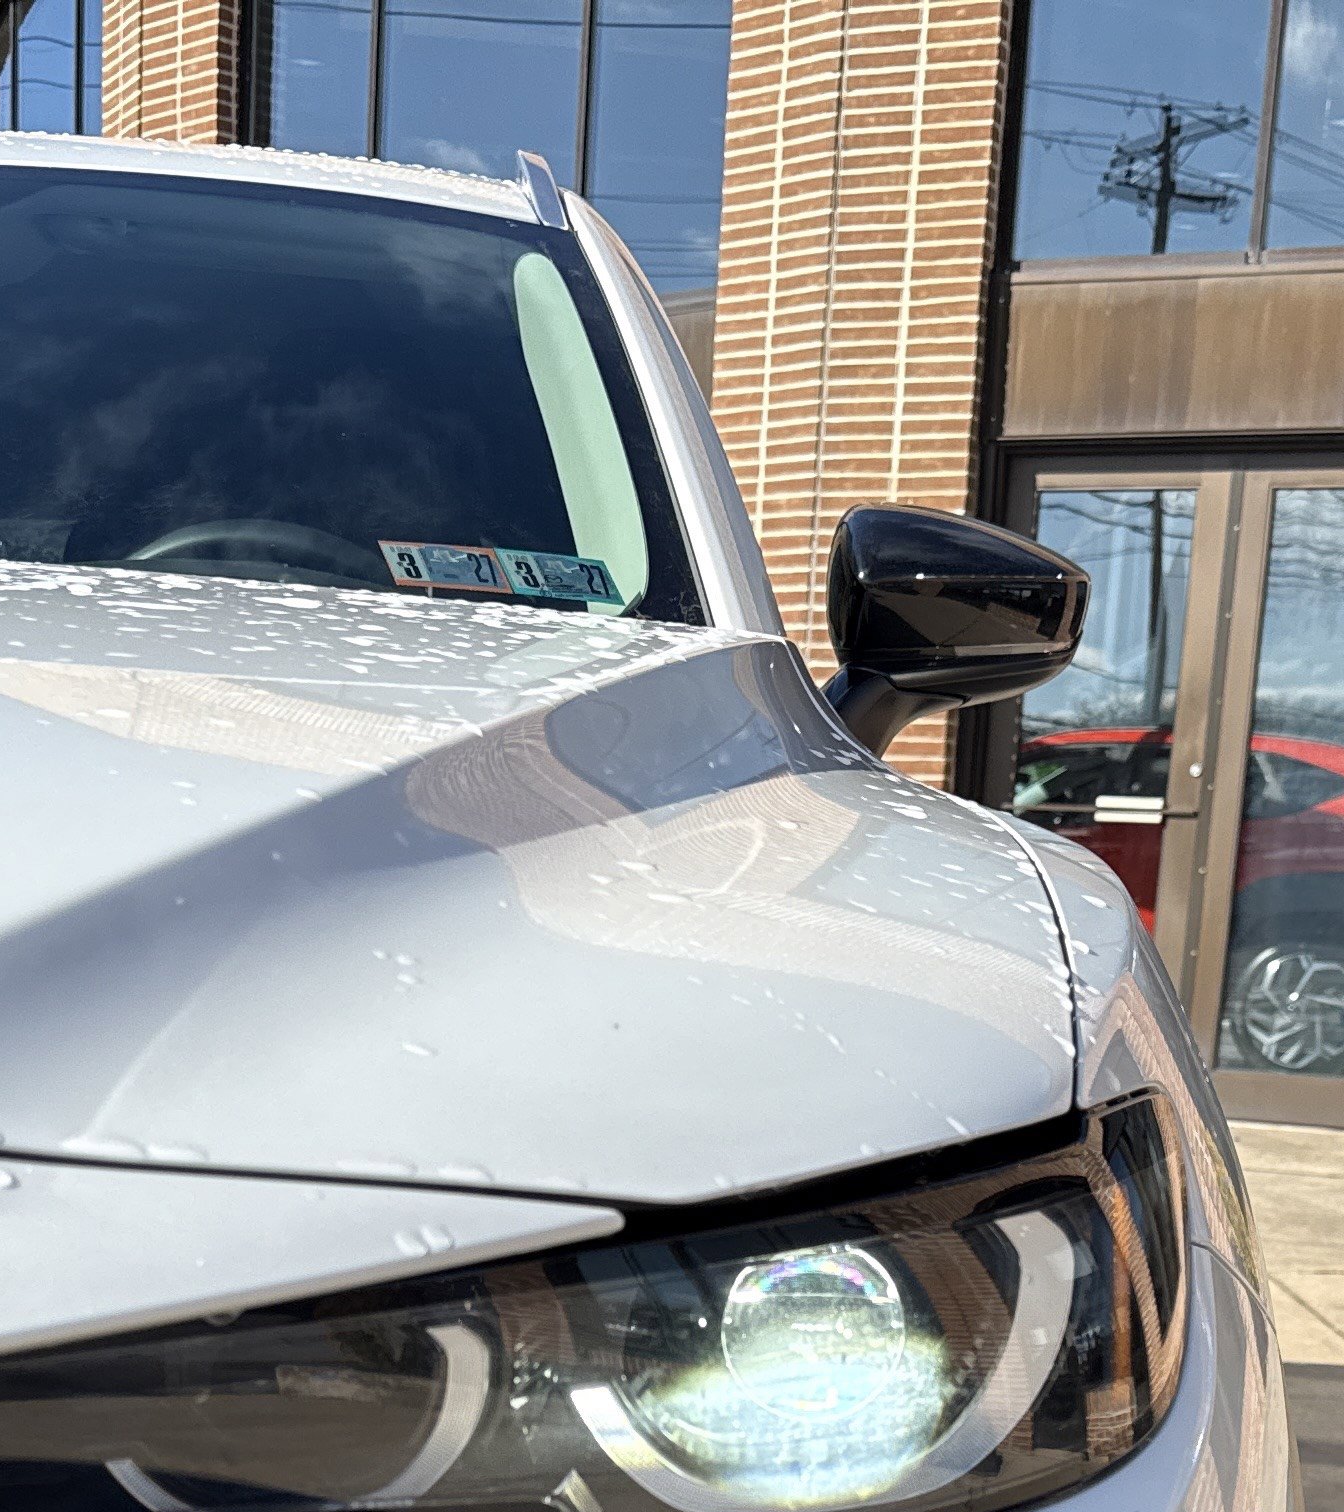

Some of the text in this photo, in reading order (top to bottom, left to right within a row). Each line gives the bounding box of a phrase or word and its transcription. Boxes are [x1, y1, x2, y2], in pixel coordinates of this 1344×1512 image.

[398, 552, 498, 587] 3 27
[515, 560, 540, 589] 3
[578, 563, 611, 599] 27
